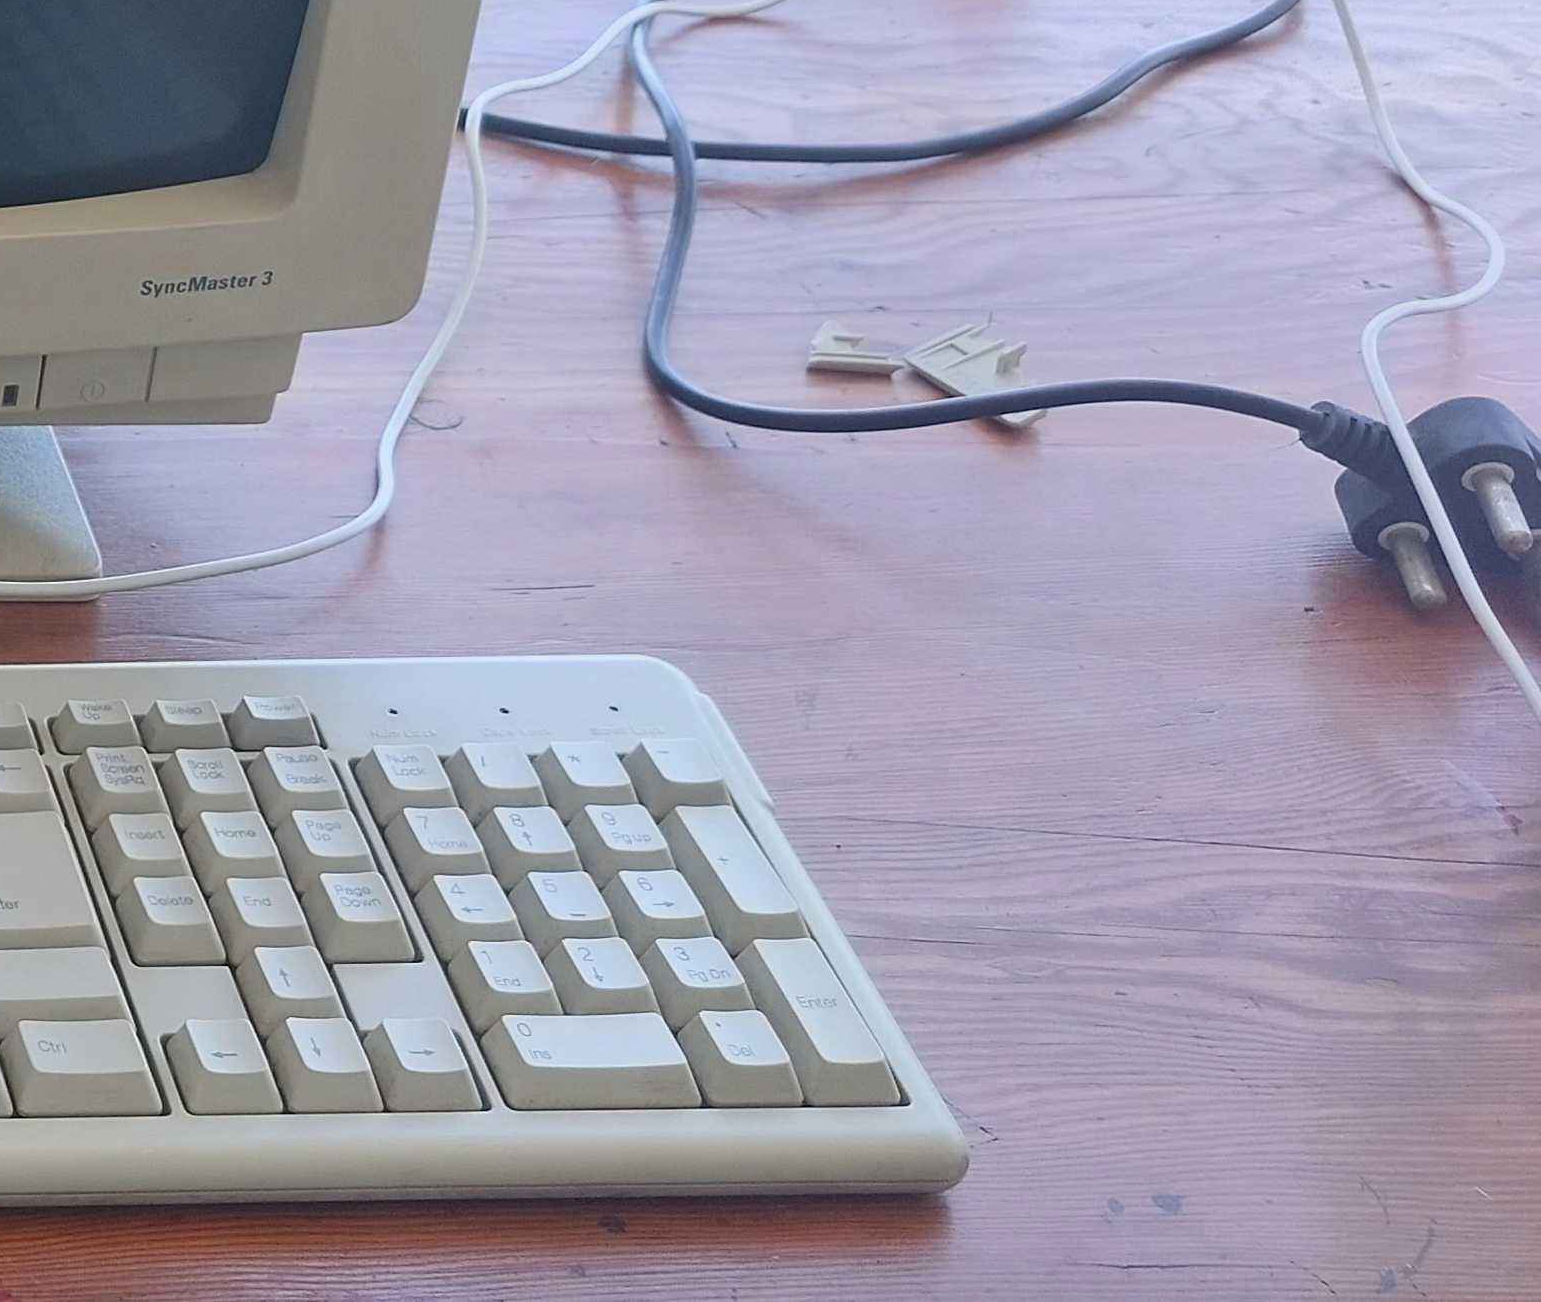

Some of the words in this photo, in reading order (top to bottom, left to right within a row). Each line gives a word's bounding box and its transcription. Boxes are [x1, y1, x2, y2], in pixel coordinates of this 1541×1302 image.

[140, 275, 258, 298] SyncMaster
[261, 270, 274, 286] 3
[417, 815, 428, 829] 7
[509, 813, 525, 828] 8
[601, 811, 617, 826] 9
[126, 829, 166, 841] Insert
[214, 827, 257, 840] Home
[449, 882, 466, 895] 4
[542, 878, 558, 893] 5
[636, 876, 654, 892] 6
[244, 896, 272, 908] End
[480, 950, 493, 965] 1
[577, 946, 594, 962] 2
[673, 946, 691, 962] 3
[493, 975, 522, 987] End
[796, 995, 839, 1009] Enter
[516, 1022, 533, 1037] 0
[37, 1039, 68, 1055] Ctrl
[728, 1043, 757, 1057] Del
[528, 1049, 552, 1061] Ins
